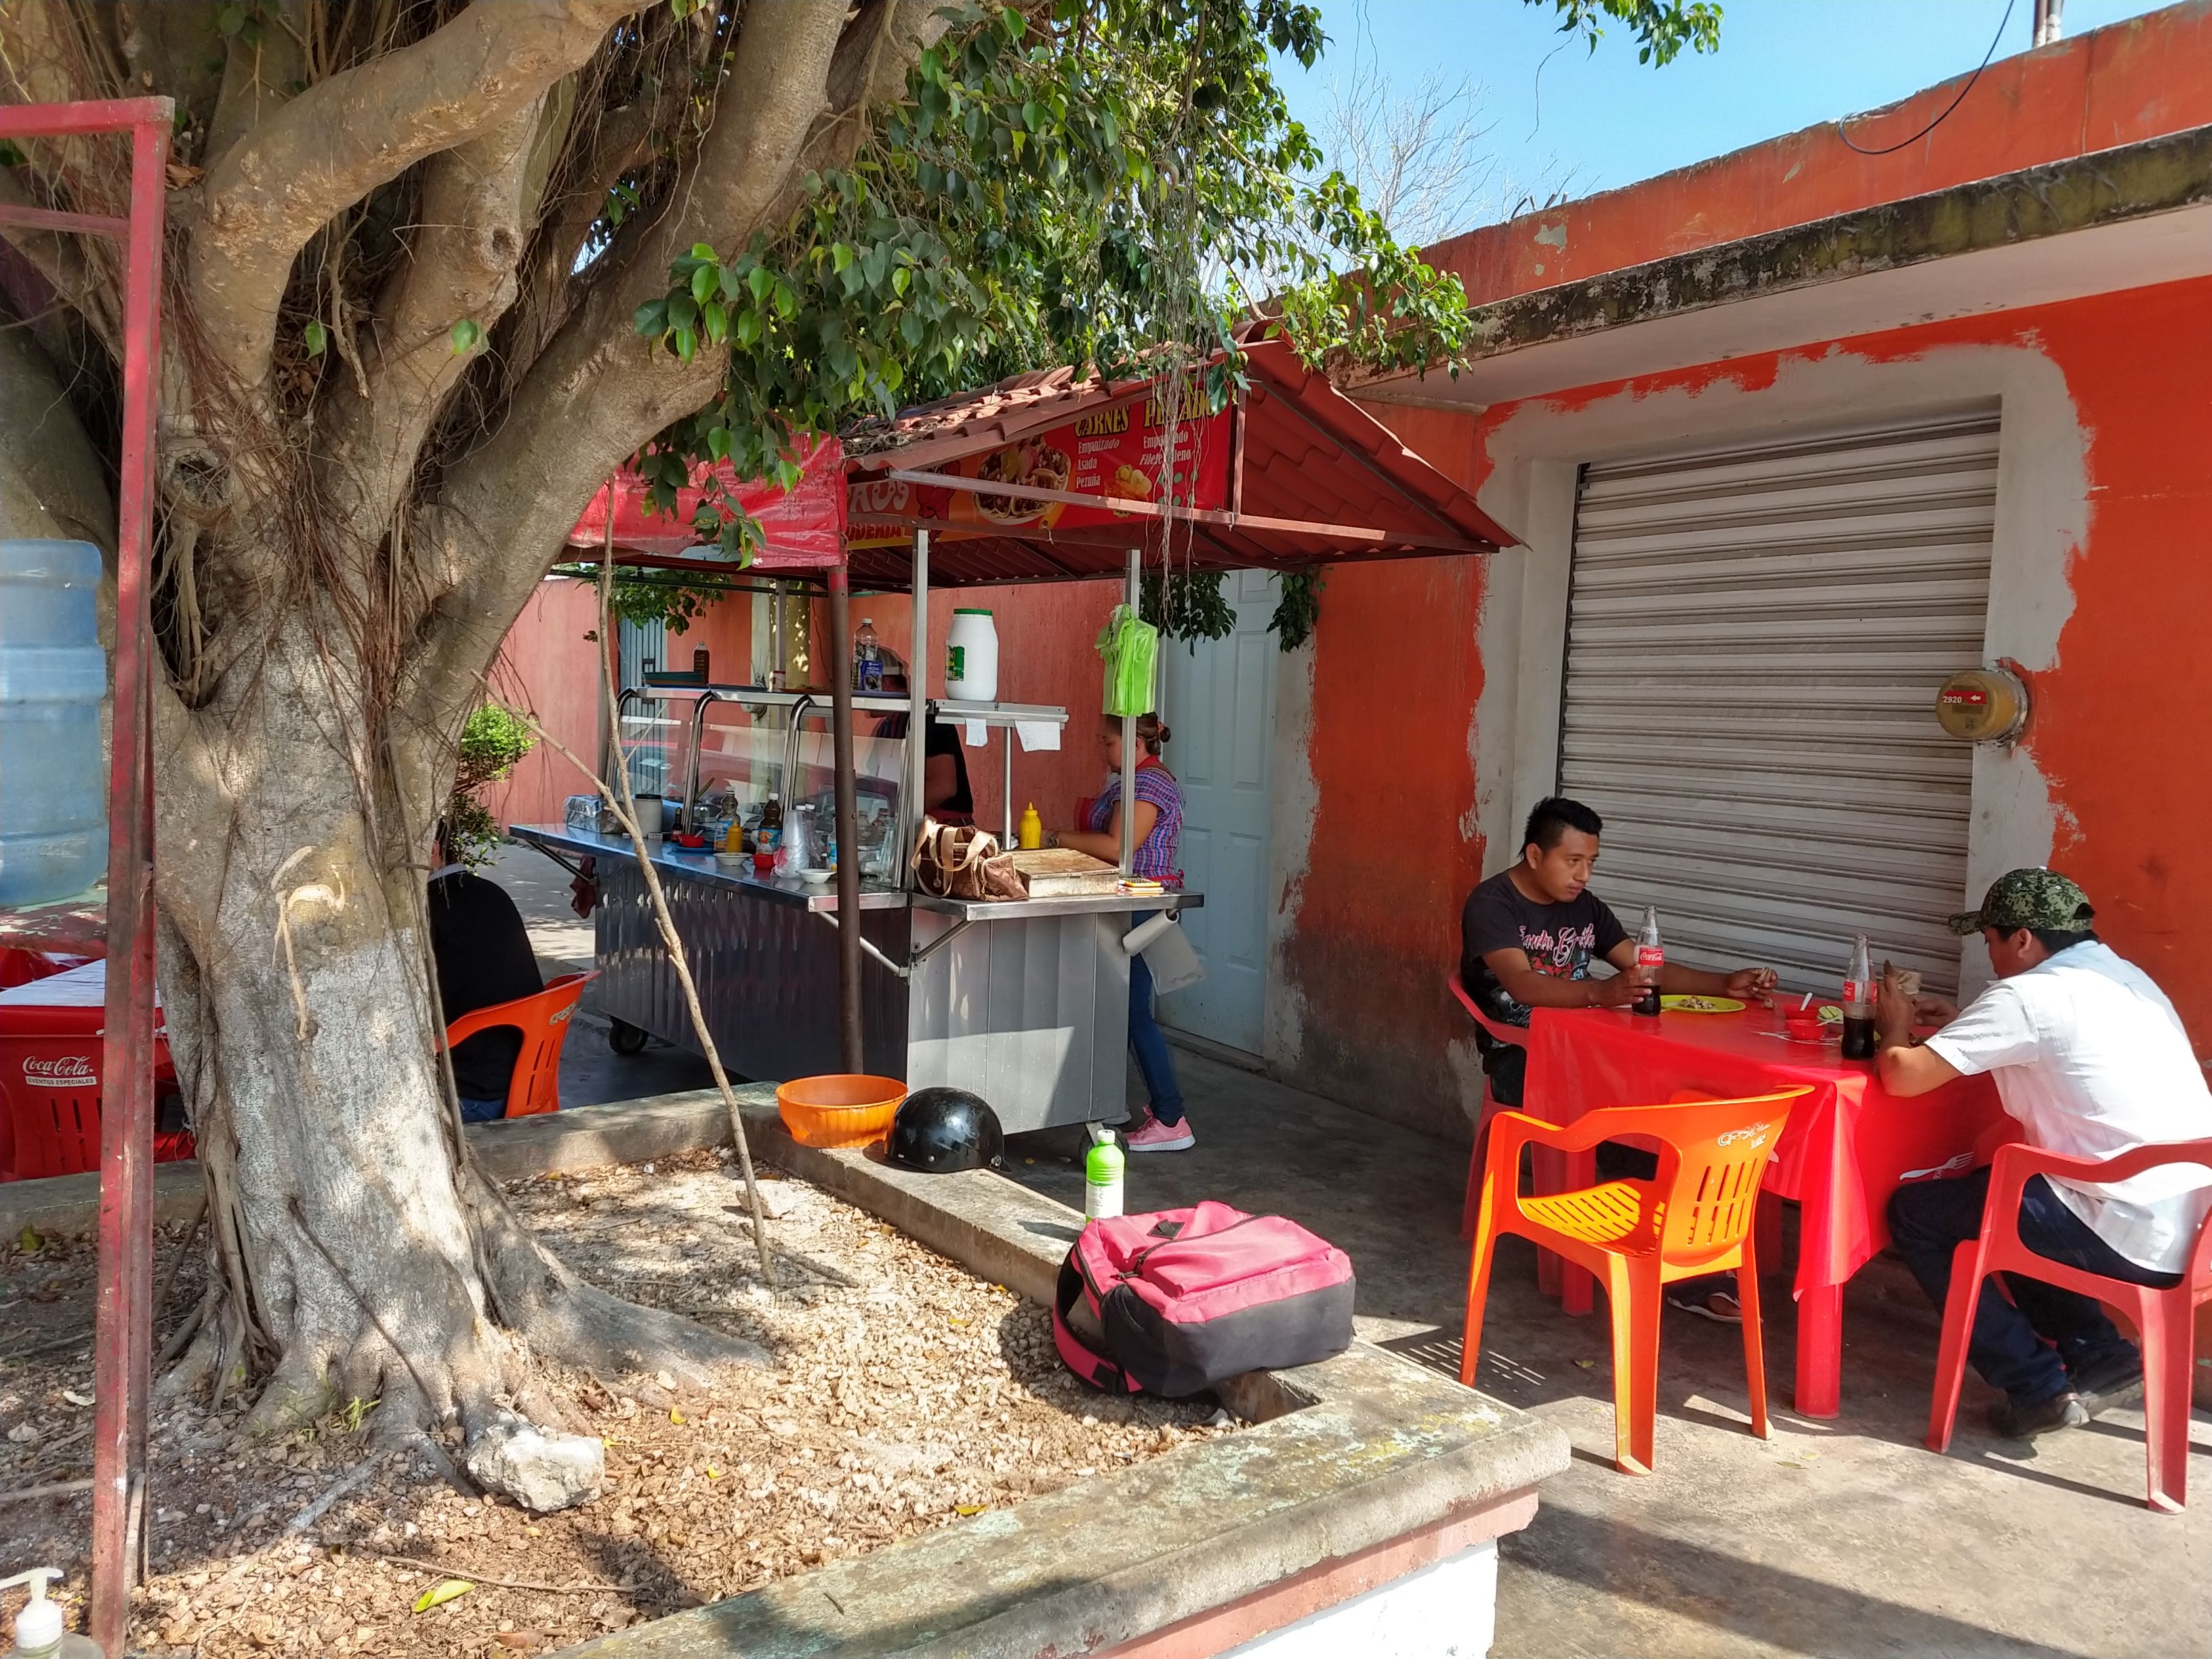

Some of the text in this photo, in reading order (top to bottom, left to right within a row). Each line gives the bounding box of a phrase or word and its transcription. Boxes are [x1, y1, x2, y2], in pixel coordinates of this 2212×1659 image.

[1078, 438, 1120, 455] Empanizado
[1077, 457, 1098, 471] Asada
[1139, 452, 1163, 466] Filete
[1076, 475, 1101, 489] Pezuña
[1942, 695, 1963, 704] 2920
[22, 1055, 91, 1076] Coca-Cola
